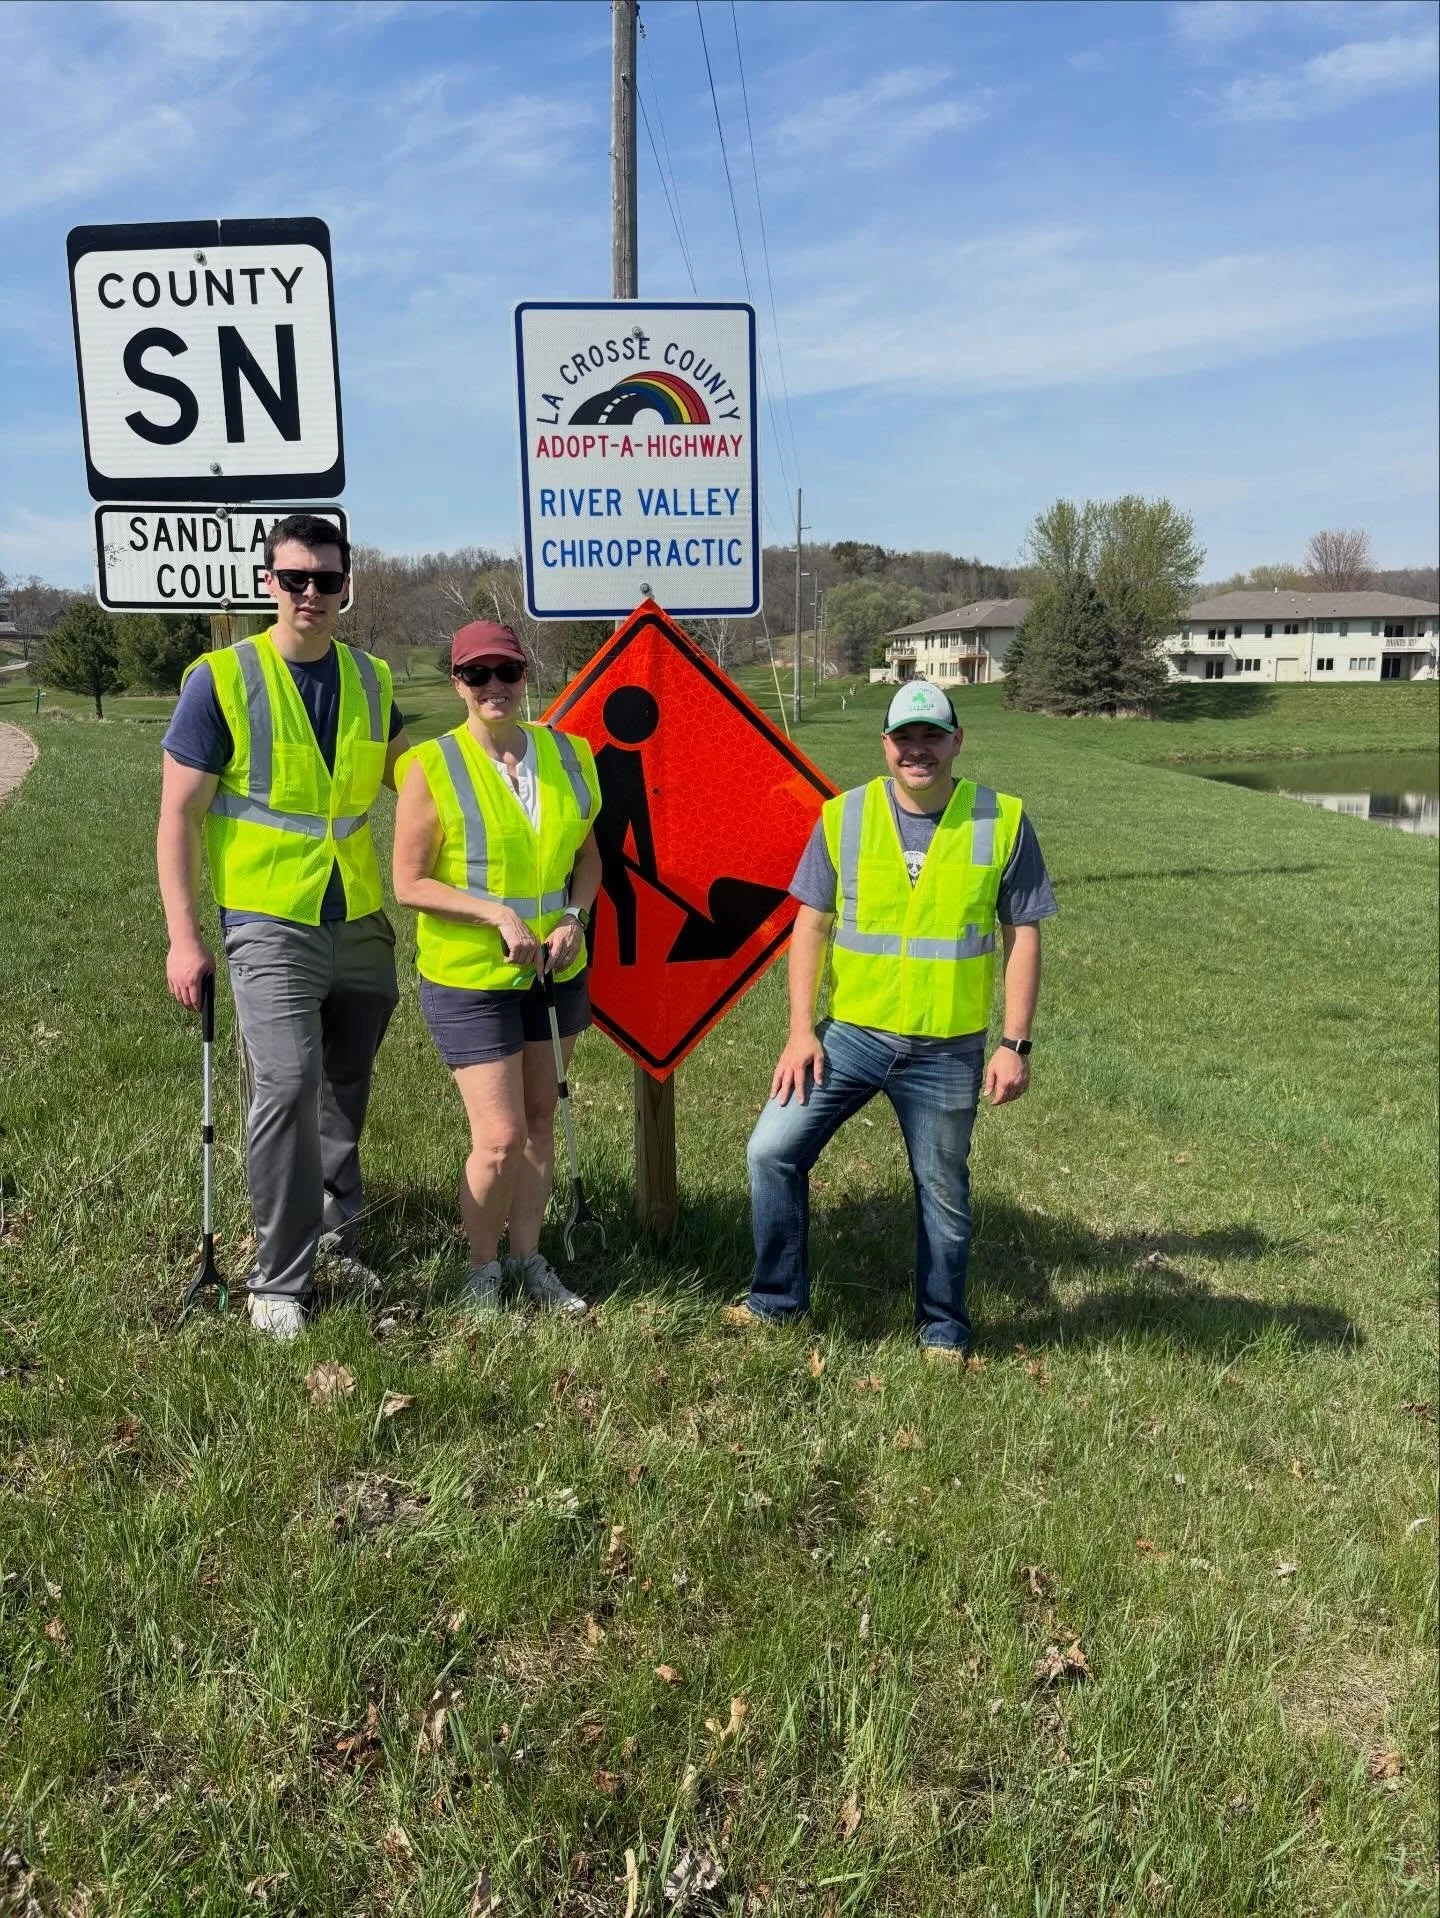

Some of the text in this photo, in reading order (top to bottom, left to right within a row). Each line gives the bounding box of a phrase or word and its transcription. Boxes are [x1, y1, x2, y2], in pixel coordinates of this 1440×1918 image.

[97, 266, 304, 310] COUNTY
[122, 323, 302, 446] SN
[536, 337, 741, 425] LA CROSSE COUNTY
[536, 434, 743, 459] ADOPT-A-HIGHWAY
[540, 487, 741, 517] RIVER VALLEY
[129, 516, 279, 553] SANDLA
[541, 538, 743, 568] CHIROPRACTIC
[156, 563, 272, 599] COULE
